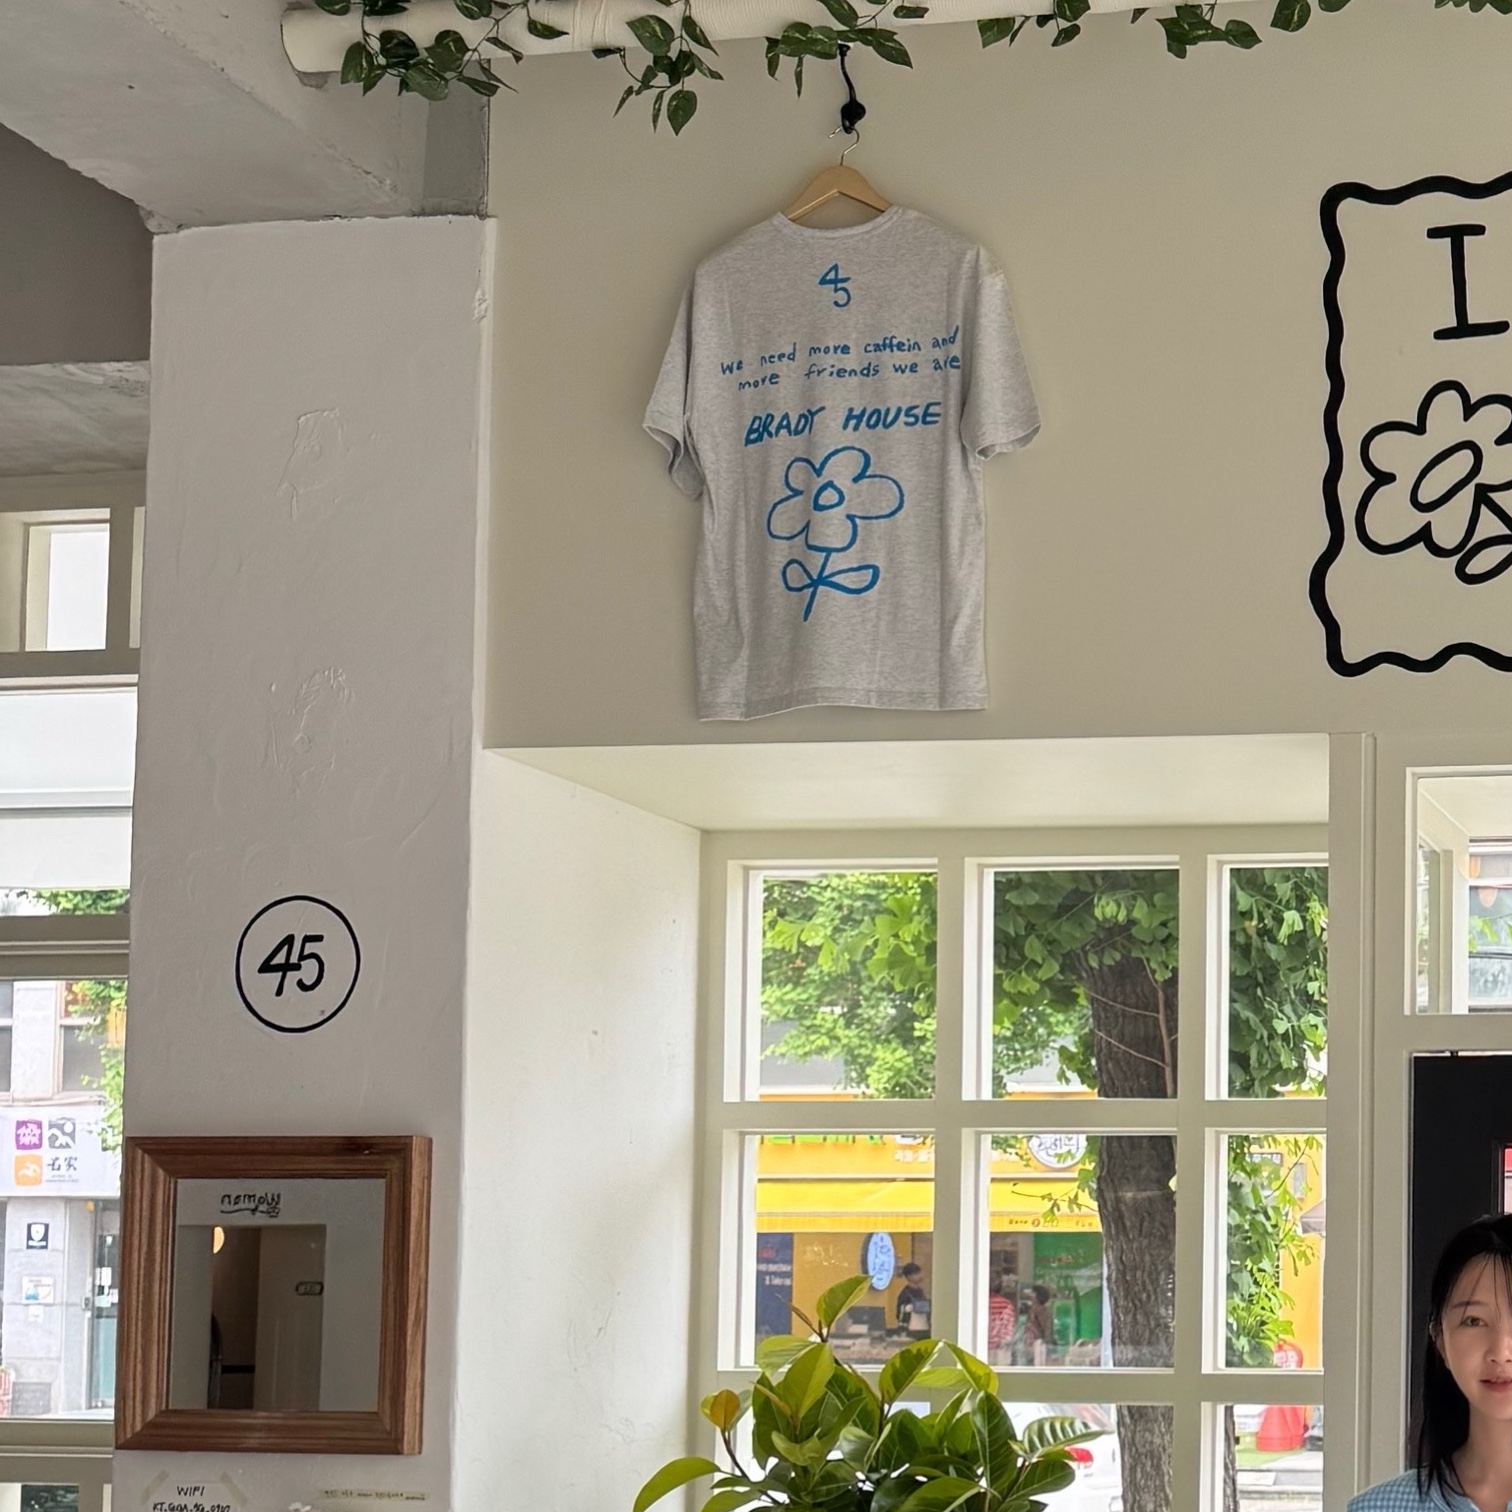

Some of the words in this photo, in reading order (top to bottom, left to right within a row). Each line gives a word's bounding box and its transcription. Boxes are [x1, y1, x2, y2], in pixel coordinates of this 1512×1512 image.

[1427, 224, 1510, 340] I
[760, 342, 797, 366] need
[808, 341, 851, 357] more
[864, 336, 922, 353] caffein
[931, 325, 959, 350] and
[738, 371, 780, 391] more
[804, 363, 881, 379] friends
[892, 361, 919, 375] we
[932, 354, 961, 371] are
[744, 406, 826, 447] BRADY
[842, 402, 942, 432] HOUSE
[258, 934, 324, 997] 45
